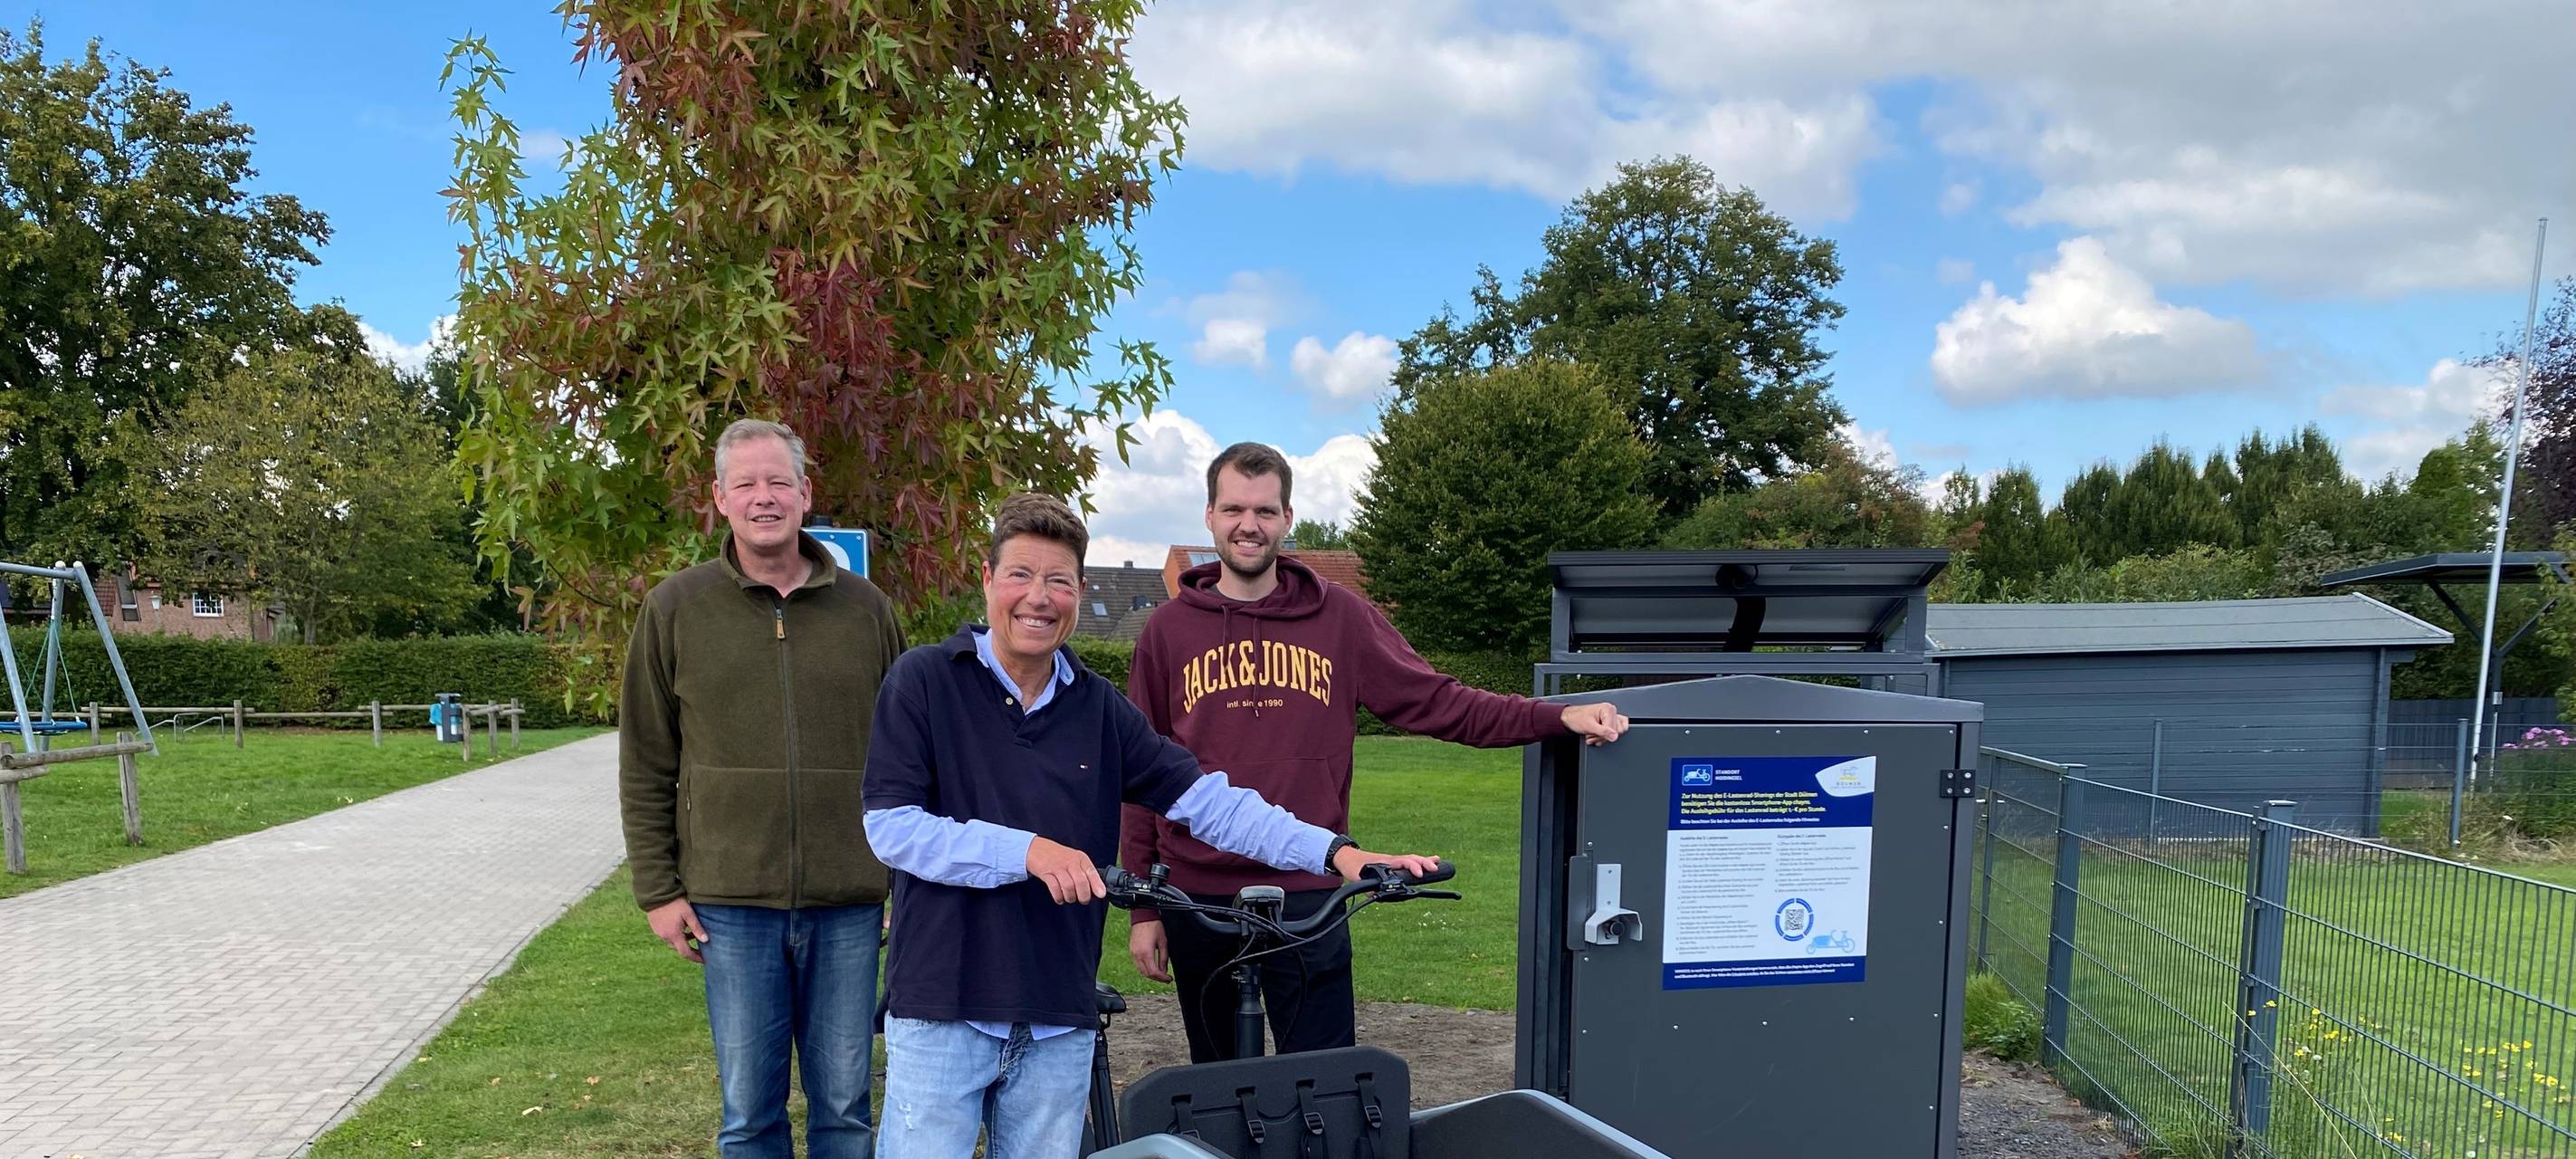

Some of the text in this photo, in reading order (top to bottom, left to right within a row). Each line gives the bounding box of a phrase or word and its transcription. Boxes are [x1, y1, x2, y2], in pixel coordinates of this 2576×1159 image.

[1183, 639, 1332, 714] JACK&JONES
[1226, 699, 1283, 709] intl. sine 1990
